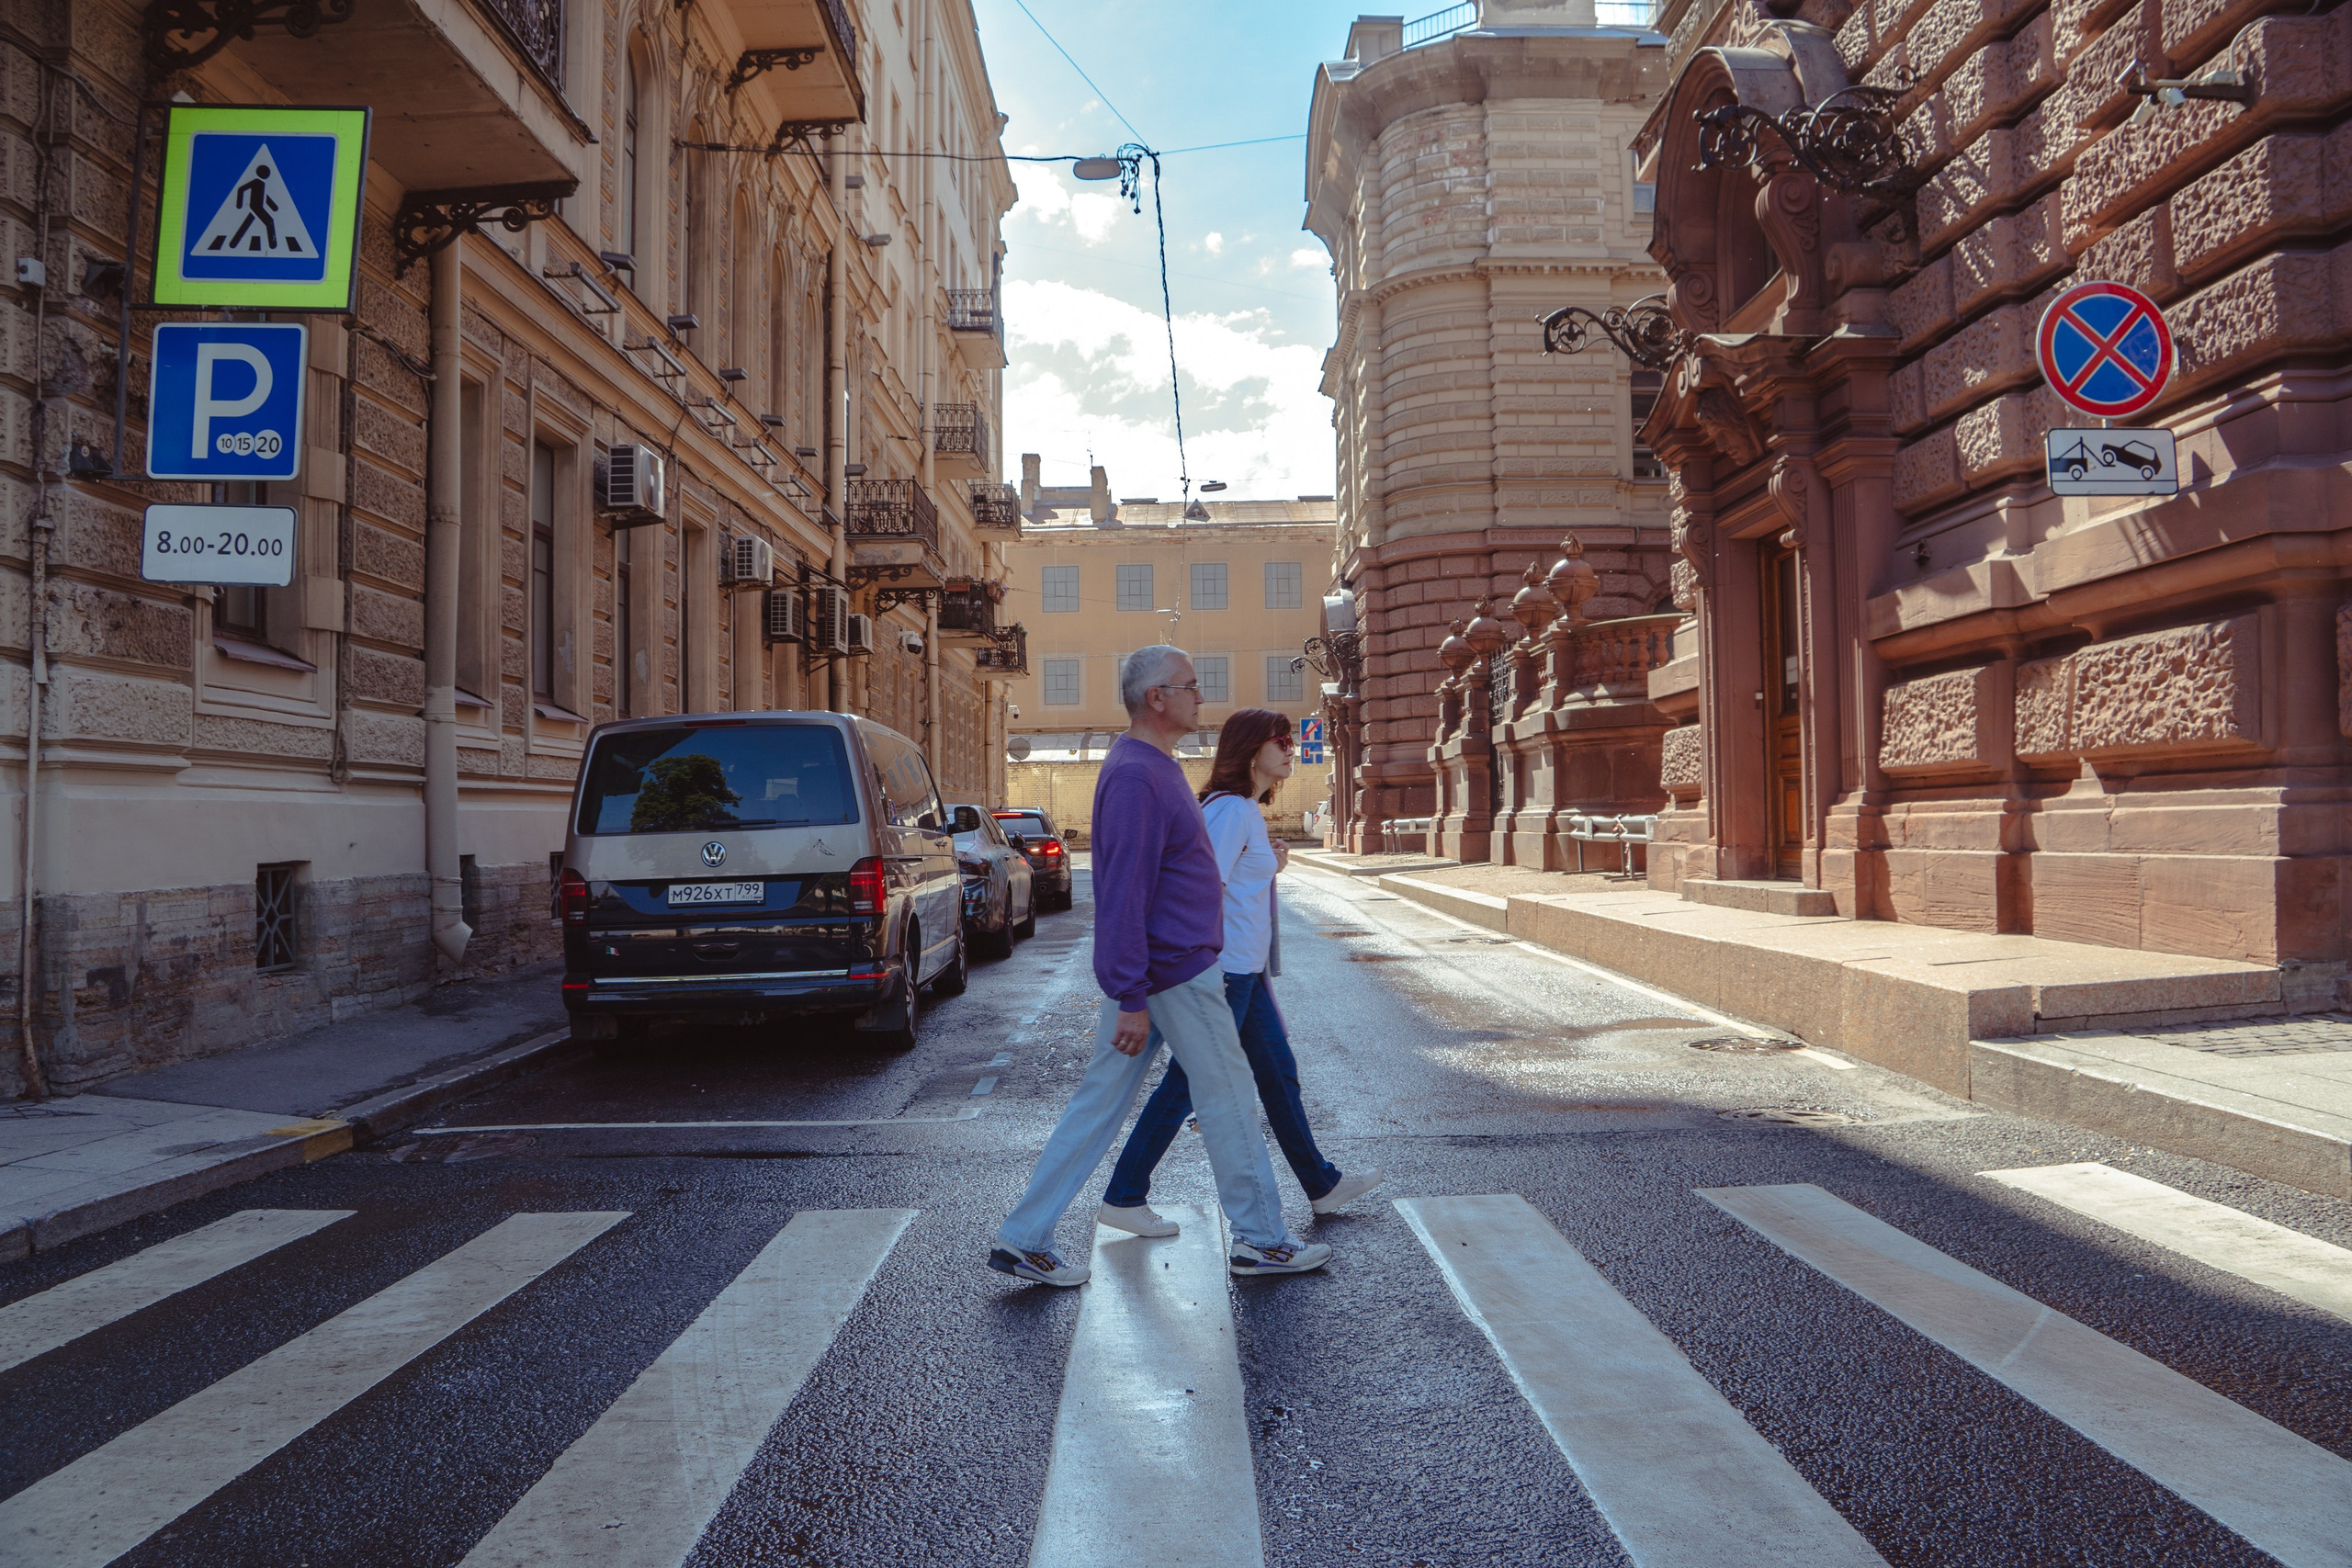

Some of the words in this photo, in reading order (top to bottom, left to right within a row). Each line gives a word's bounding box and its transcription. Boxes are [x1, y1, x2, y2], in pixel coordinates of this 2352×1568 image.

[191, 343, 274, 459] P
[255, 435, 280, 454] 20
[156, 530, 283, 557] 8.00-20.00
[737, 883, 760, 895] 799
